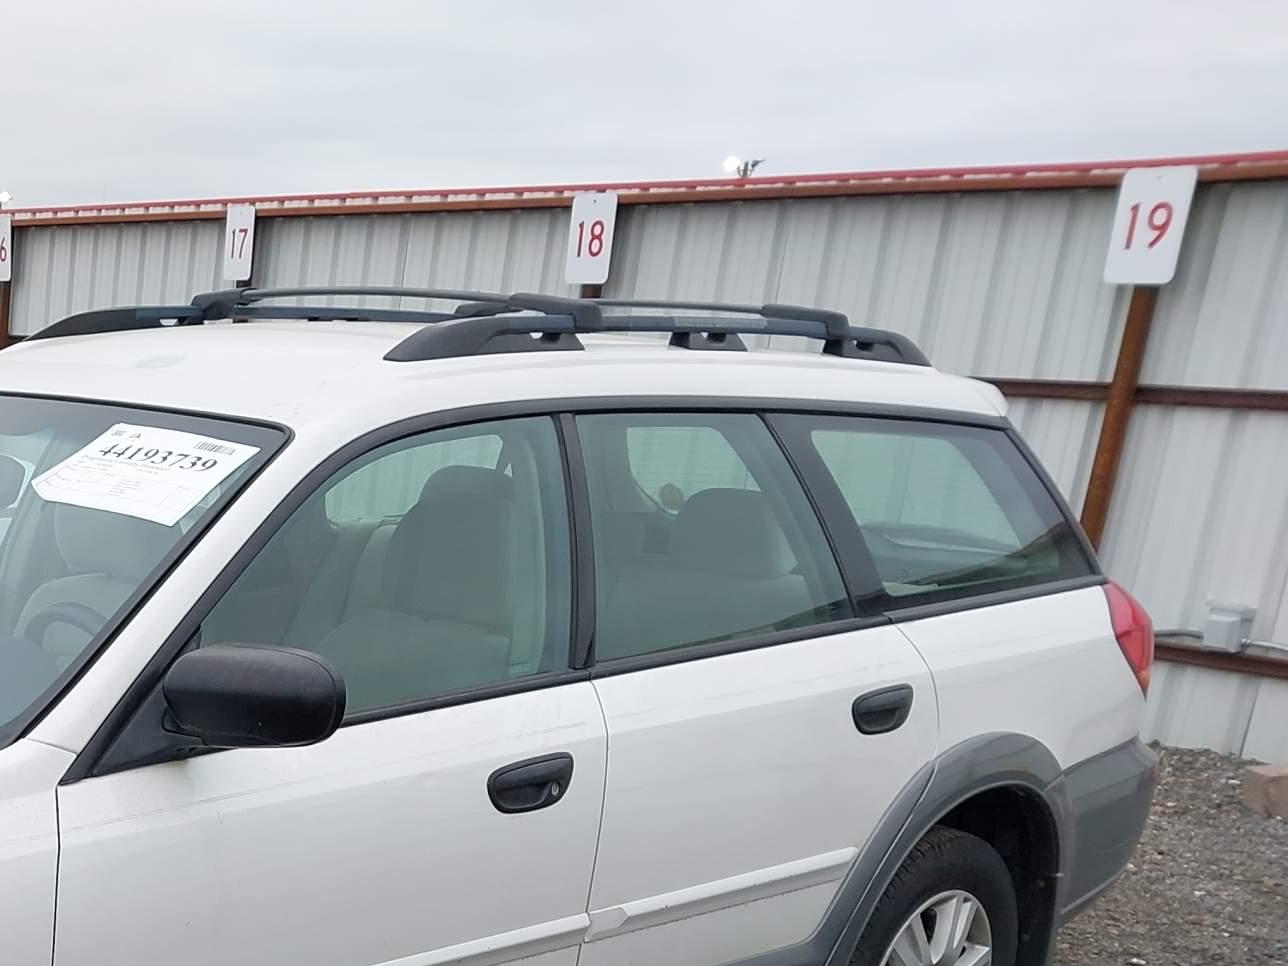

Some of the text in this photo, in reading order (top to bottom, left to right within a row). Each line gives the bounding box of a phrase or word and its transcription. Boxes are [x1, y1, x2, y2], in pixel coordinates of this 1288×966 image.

[576, 219, 605, 258] 18
[1124, 201, 1174, 250] 19
[229, 228, 250, 259] 17
[98, 443, 218, 472] 44193739
